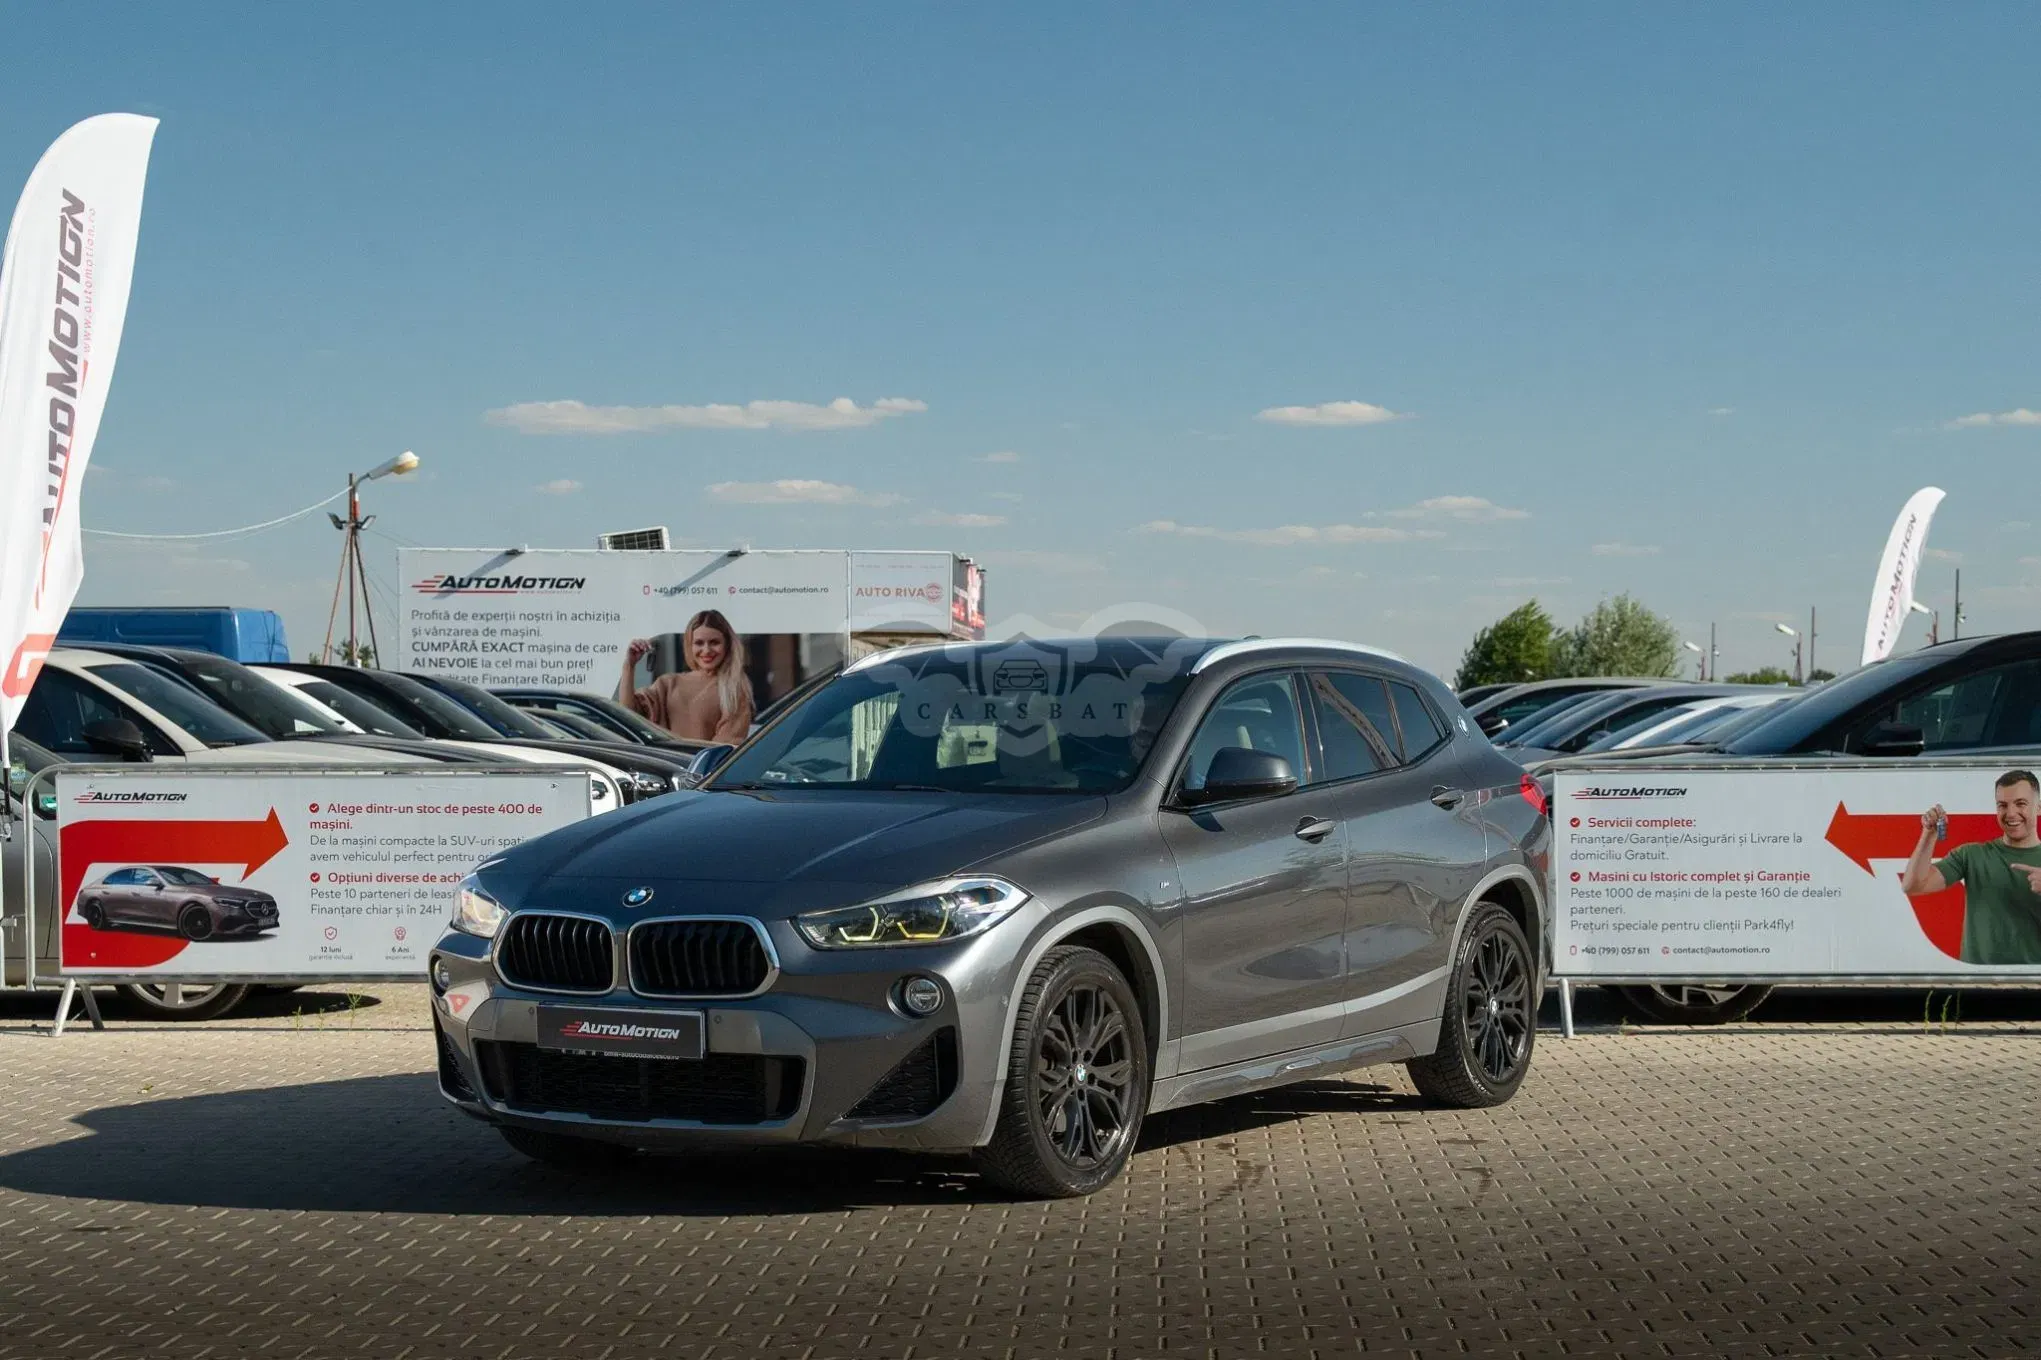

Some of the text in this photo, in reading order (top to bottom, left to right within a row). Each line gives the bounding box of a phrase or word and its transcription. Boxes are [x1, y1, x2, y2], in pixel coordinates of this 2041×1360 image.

[739, 586, 829, 594] contact@automotion.ro
[856, 587, 892, 597] AUTO
[895, 587, 926, 597] RIVA
[411, 609, 620, 625] Profită de experții noștri în achiziția
[412, 625, 542, 640] și vânzarea de mașini.
[412, 640, 618, 656] CUMPĂRĂ EXACT mașina de care
[412, 658, 594, 672] AI NEVOIE la cel mai bun preț!
[482, 674, 538, 688] Finanțare
[542, 674, 586, 688] Rapidă!
[327, 804, 542, 816] Alege dintr-un stoc de peste 400 de
[310, 820, 352, 832] mașini.
[1588, 817, 1696, 829] Servicii complete:
[310, 836, 326, 846] De
[330, 836, 338, 846] la
[342, 836, 376, 849] mașini
[380, 836, 435, 848] compacte
[438, 836, 447, 846] la
[450, 836, 495, 846] SUV-uri
[1570, 833, 1802, 847] Finanțare/Garanție/Asigurări și Livrare la
[310, 854, 340, 862] avem
[342, 852, 391, 862] vehiculul
[394, 852, 434, 864] perfect
[438, 852, 474, 864] pentru
[1570, 850, 1669, 860] domiciliu Gratuit.
[328, 872, 372, 886] Opțiuni
[376, 872, 419, 882] diverse
[422, 872, 436, 882] de
[1632, 874, 1647, 882] cu
[1650, 872, 1688, 882] Istoric
[1690, 871, 1740, 883] complet
[1744, 872, 1754, 884] și
[1758, 870, 1810, 884] Garanție
[310, 888, 342, 898] Peste
[344, 888, 356, 898] 10
[360, 889, 410, 901] parteneri
[414, 888, 428, 898] de
[1570, 887, 1842, 901] Peste 1000 de mașini de la peste 160 de dealeri
[310, 904, 362, 918] Finanțare
[366, 904, 392, 914] chiar
[396, 904, 404, 918] și
[420, 904, 442, 914] 24H
[1570, 904, 1626, 916] parteneri.
[1570, 920, 1794, 934] Prețuri speciale pentru clienții Park4fly!
[1582, 946, 1650, 956] +40 (799) 057 611
[1672, 946, 1770, 954] contact@automotion.ro
[578, 1021, 680, 1040] AUTOMOTION
